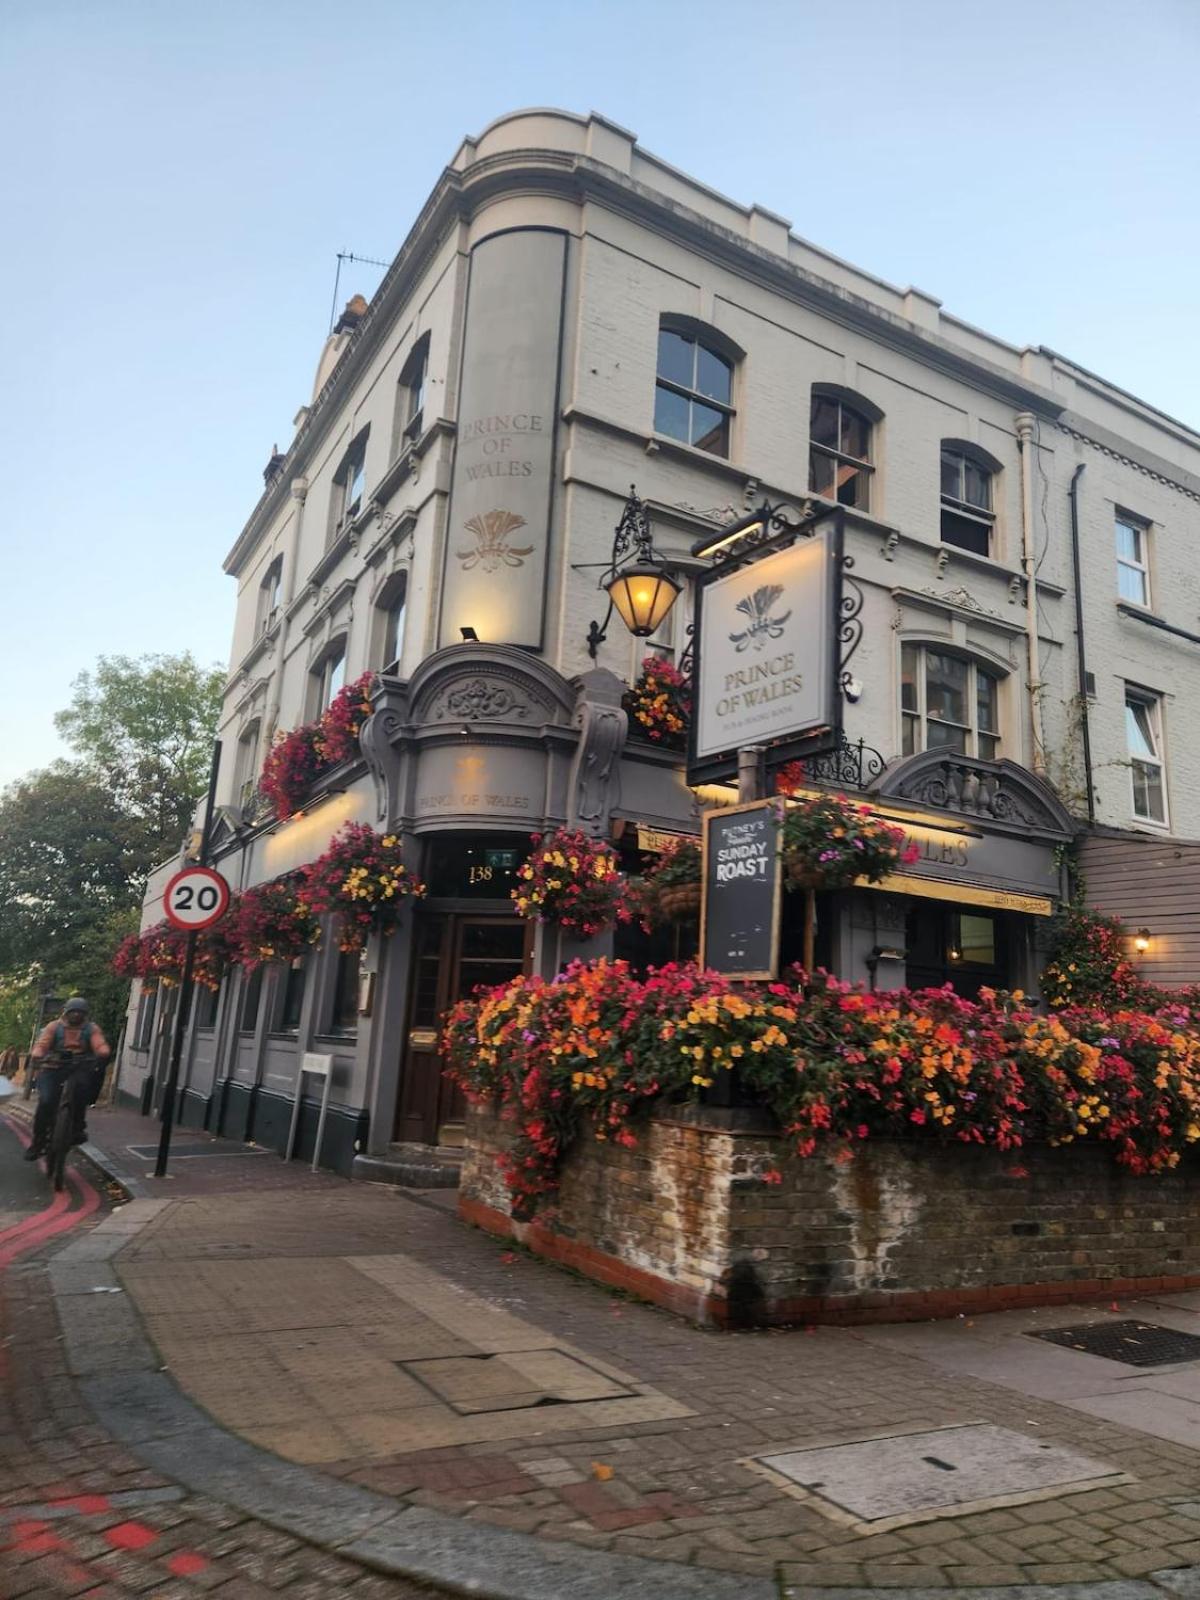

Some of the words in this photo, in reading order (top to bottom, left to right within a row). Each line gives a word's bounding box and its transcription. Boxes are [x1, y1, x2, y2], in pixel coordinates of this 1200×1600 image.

[464, 415, 543, 438] PRINCE
[483, 438, 511, 455] OF
[466, 461, 532, 480] WALES
[725, 653, 794, 691] PRINCE
[716, 695, 740, 716] OF
[742, 674, 802, 708] WALES
[463, 794, 480, 806] OF
[485, 795, 529, 809] WALES
[717, 842, 767, 861] SUNDAY
[469, 866, 493, 881] 138
[717, 857, 769, 881] ROAST
[175, 886, 218, 910] 20
